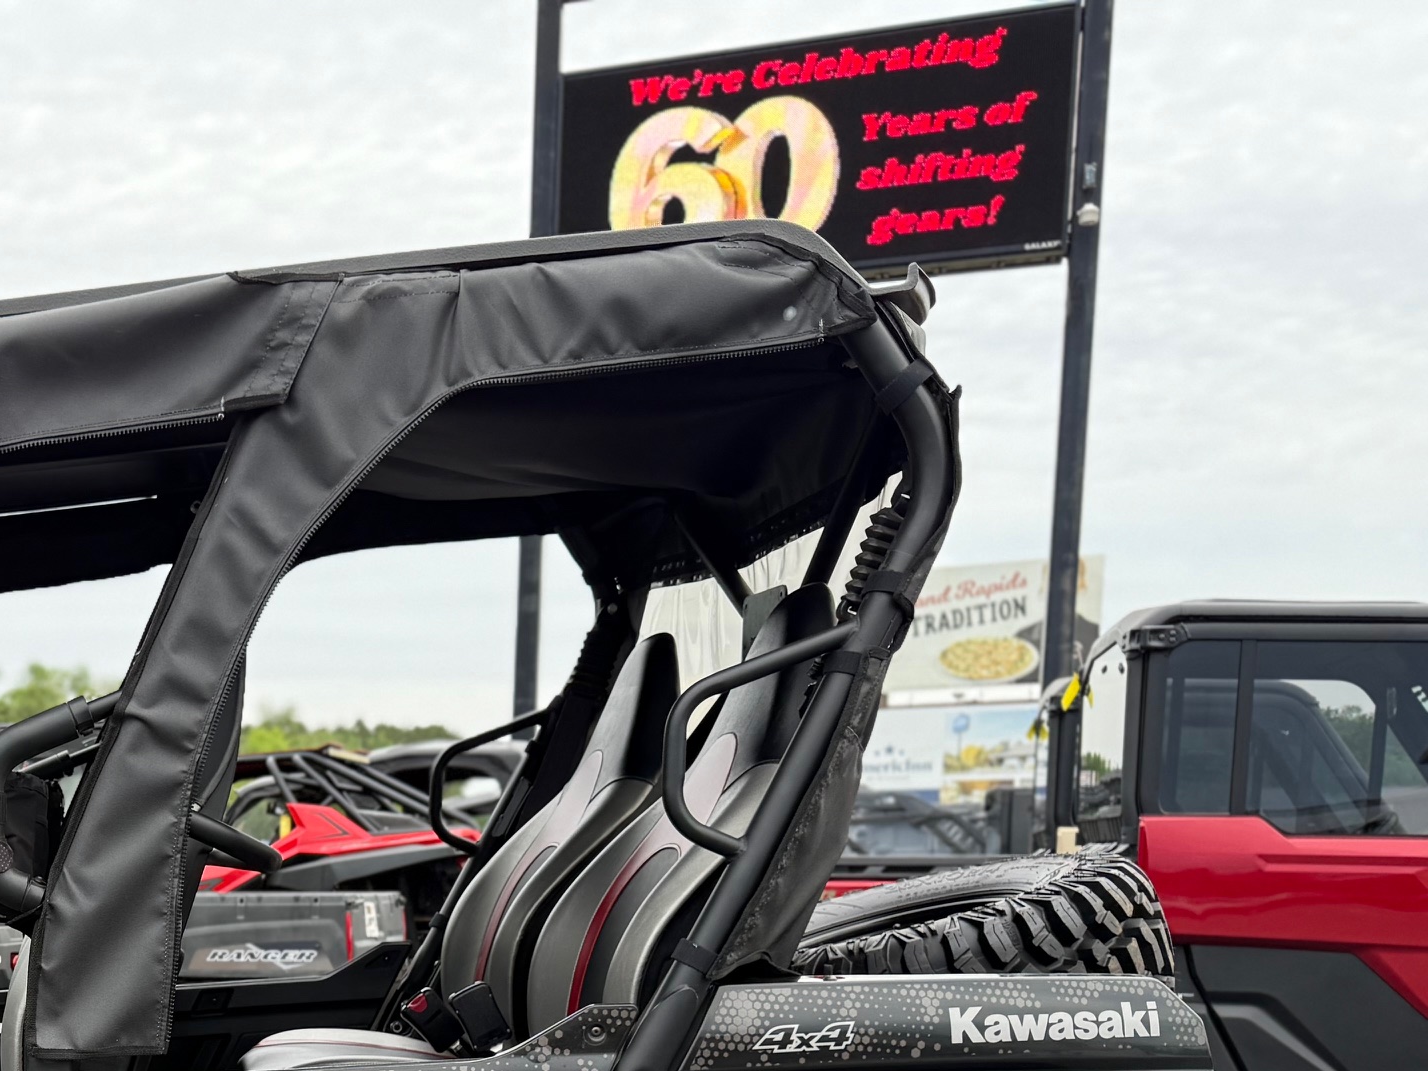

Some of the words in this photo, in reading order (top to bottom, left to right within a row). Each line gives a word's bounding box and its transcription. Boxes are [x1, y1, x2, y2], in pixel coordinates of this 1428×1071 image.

[629, 69, 745, 106] We're
[752, 27, 1008, 90] Celebrating
[862, 105, 980, 142] Years
[983, 90, 1038, 126] of
[608, 95, 841, 235] 60
[856, 144, 1026, 191] shifting
[866, 194, 1005, 246] gears!
[914, 585, 951, 609] and
[954, 571, 1028, 599] Rapids
[912, 596, 1027, 637] TRADITION
[206, 943, 319, 971] RANGER
[752, 1020, 856, 1054] 4x4
[948, 1001, 1161, 1045] Kawasaki
